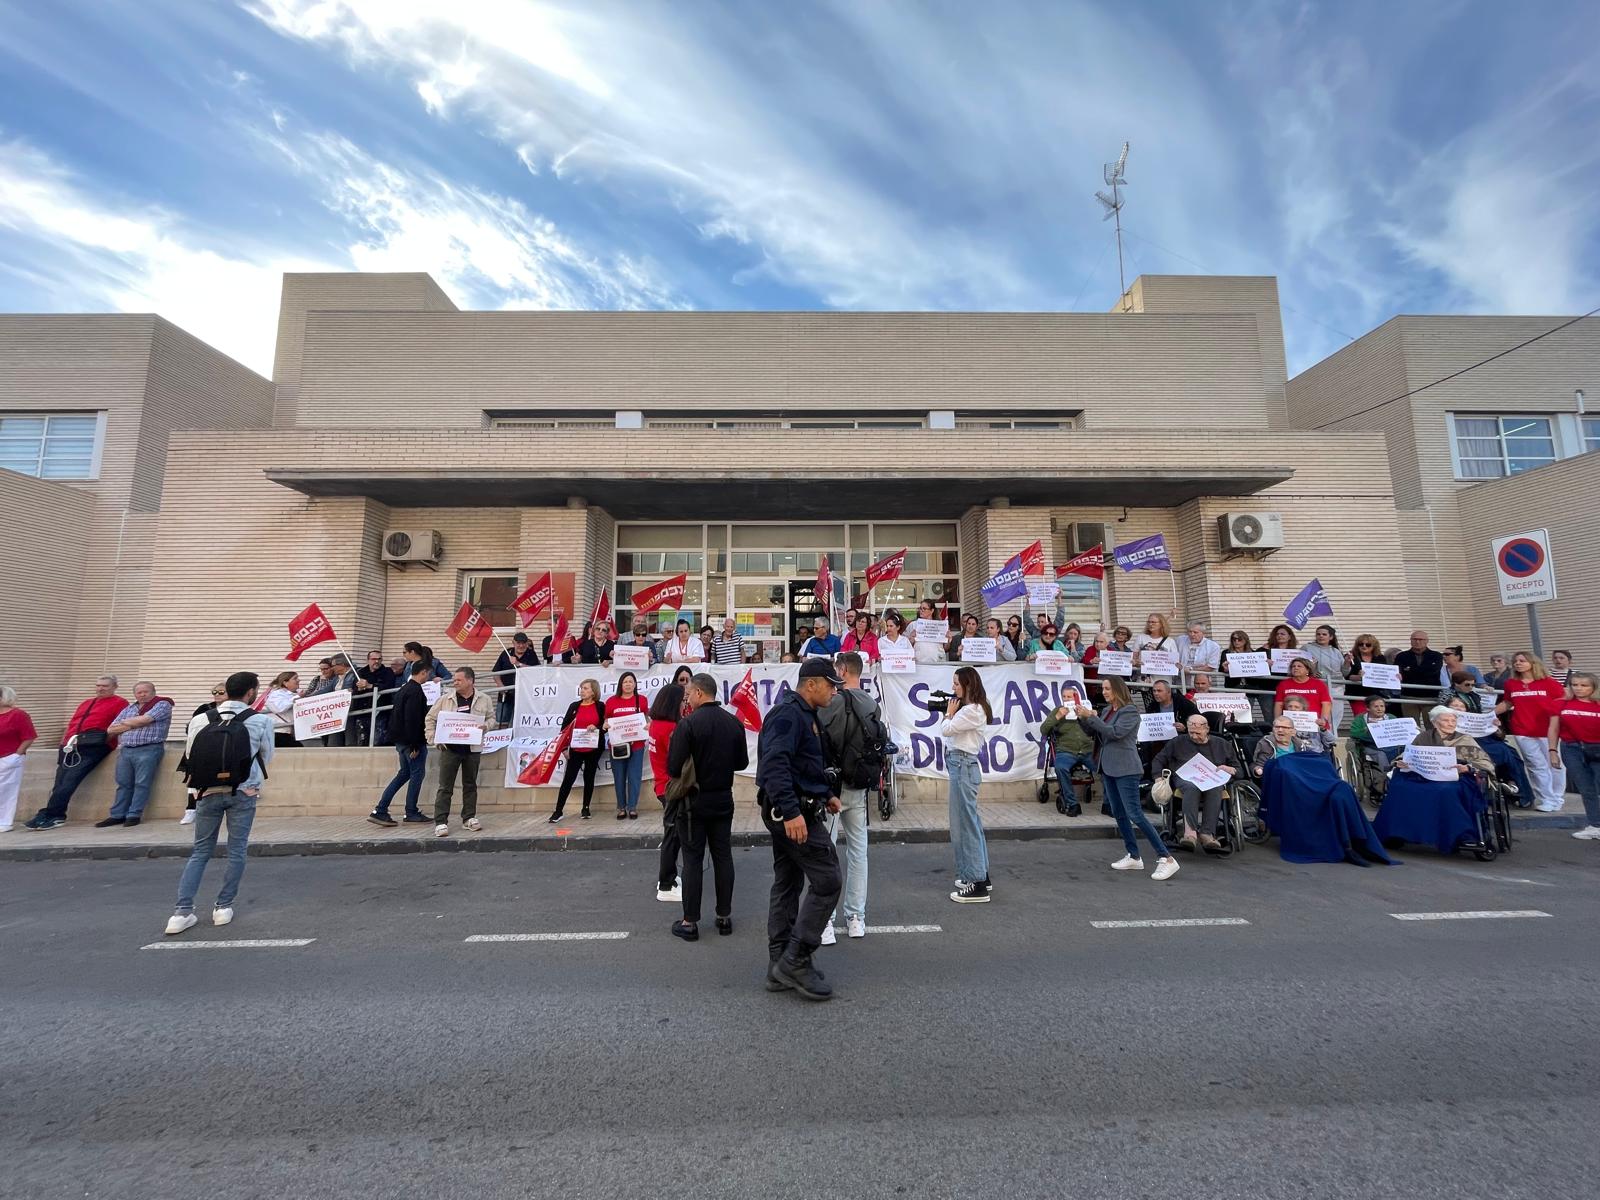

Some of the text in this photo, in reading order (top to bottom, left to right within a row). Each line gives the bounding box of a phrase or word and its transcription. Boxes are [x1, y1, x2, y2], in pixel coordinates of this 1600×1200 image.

[1506, 580, 1545, 591] EXCEPTO
[534, 686, 557, 697] SIN
[296, 701, 351, 718] ¡LICITACIONES
[317, 711, 333, 721] YA!
